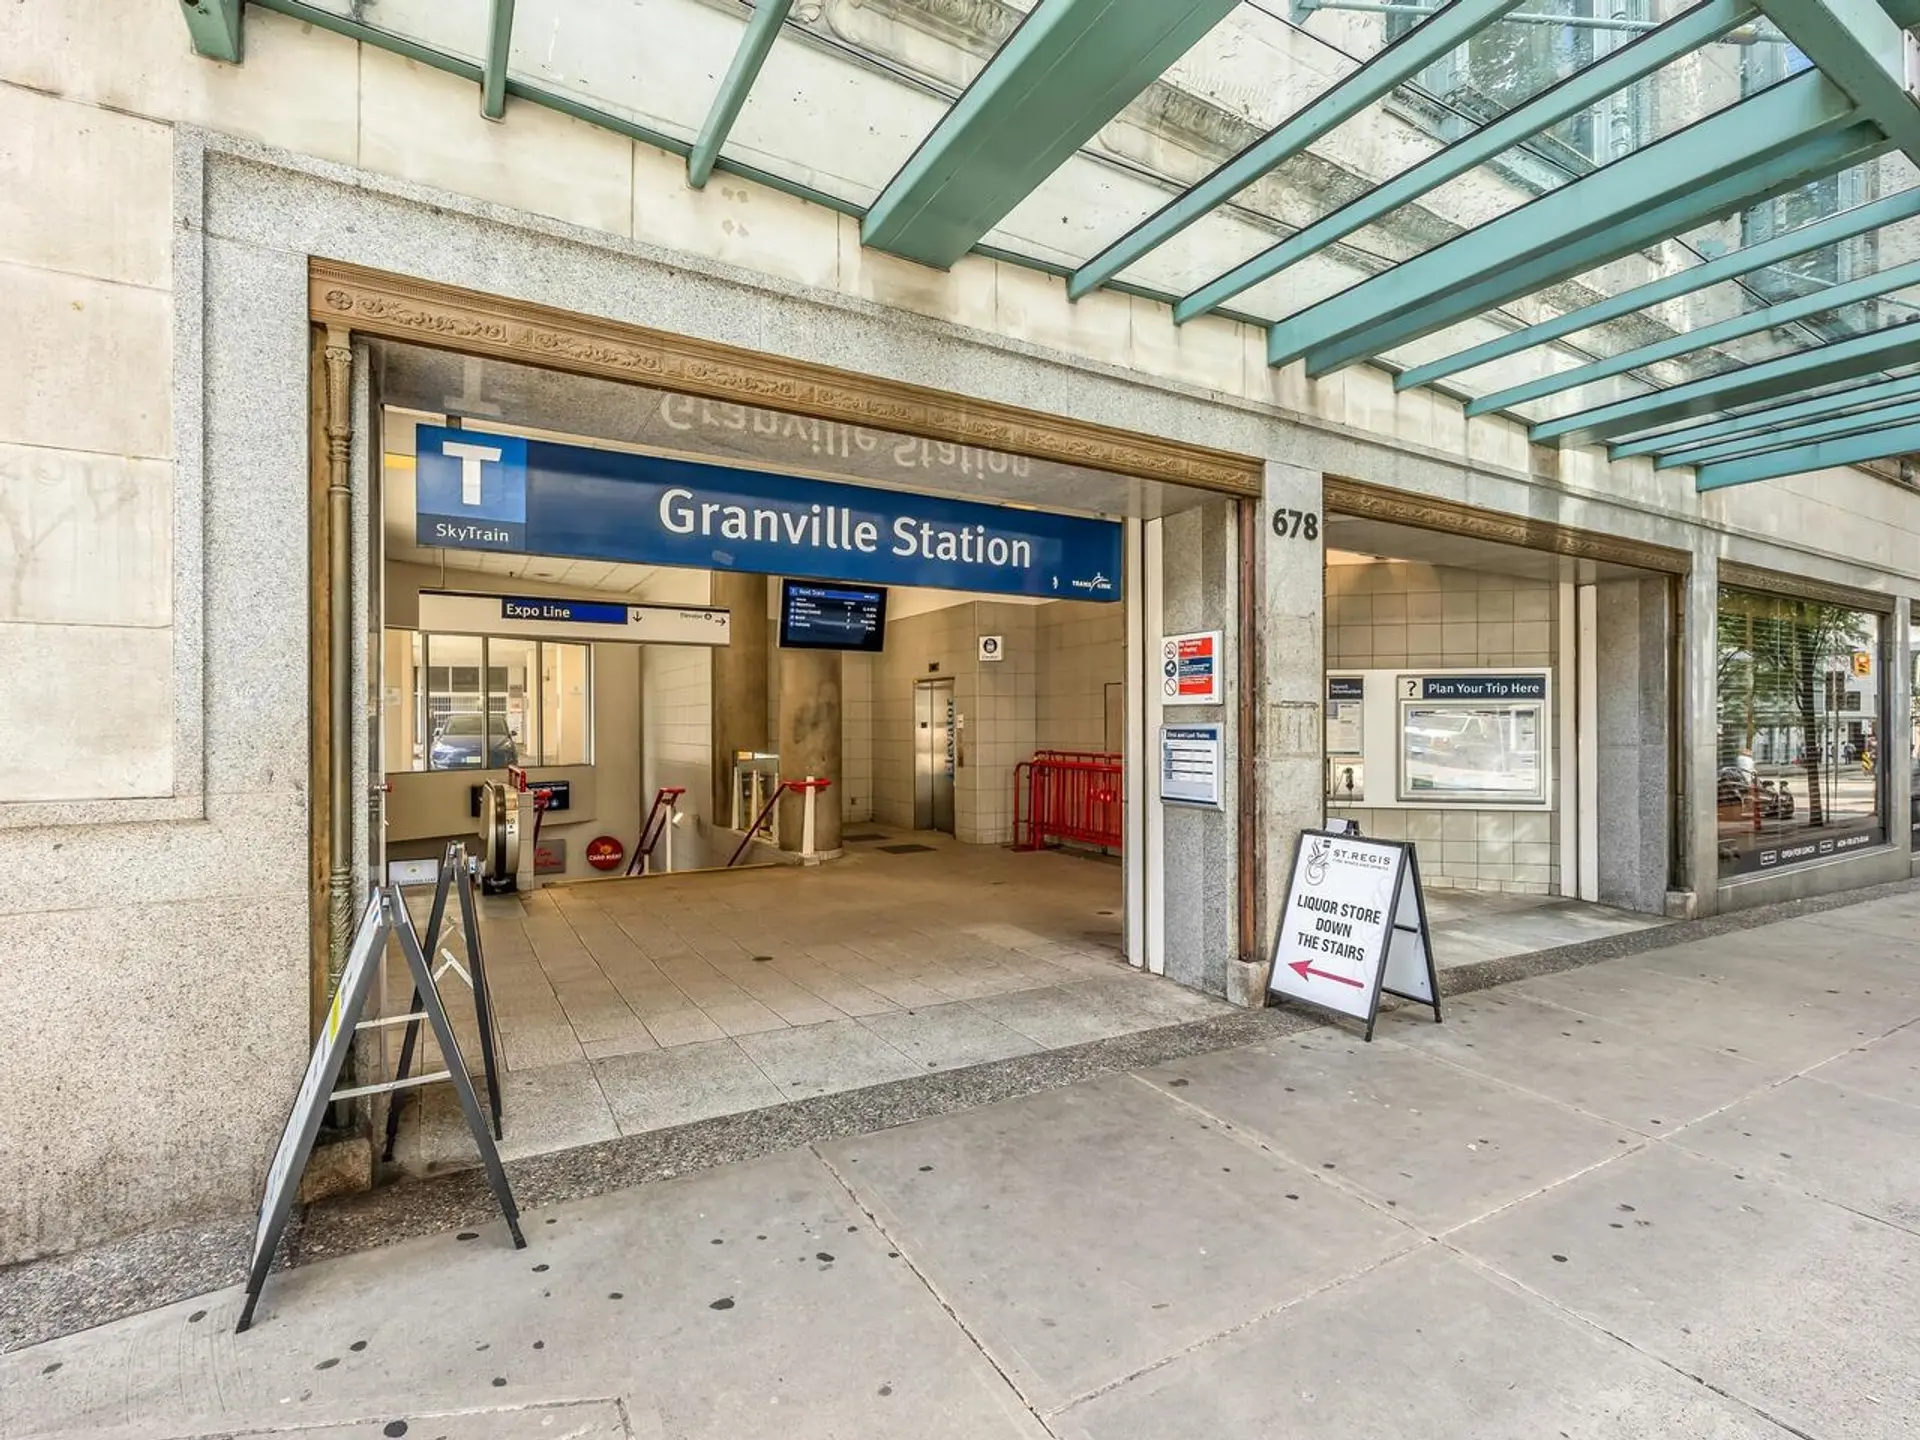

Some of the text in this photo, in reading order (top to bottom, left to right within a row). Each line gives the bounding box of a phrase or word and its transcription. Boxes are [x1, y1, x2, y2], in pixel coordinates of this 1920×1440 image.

[442, 440, 502, 505] T
[435, 523, 509, 542] SkyTrain
[660, 489, 1031, 569] Granville Station
[1272, 508, 1318, 541] 678
[506, 603, 570, 618] Expo Line
[1428, 683, 1454, 694] Plan
[1457, 683, 1482, 694] Your
[1485, 683, 1508, 695] Trip
[1511, 684, 1540, 694] Here
[1297, 894, 1381, 925] LIQUOR STORE
[1315, 917, 1352, 938] DOWN
[1297, 931, 1365, 962] THE STAIRS
